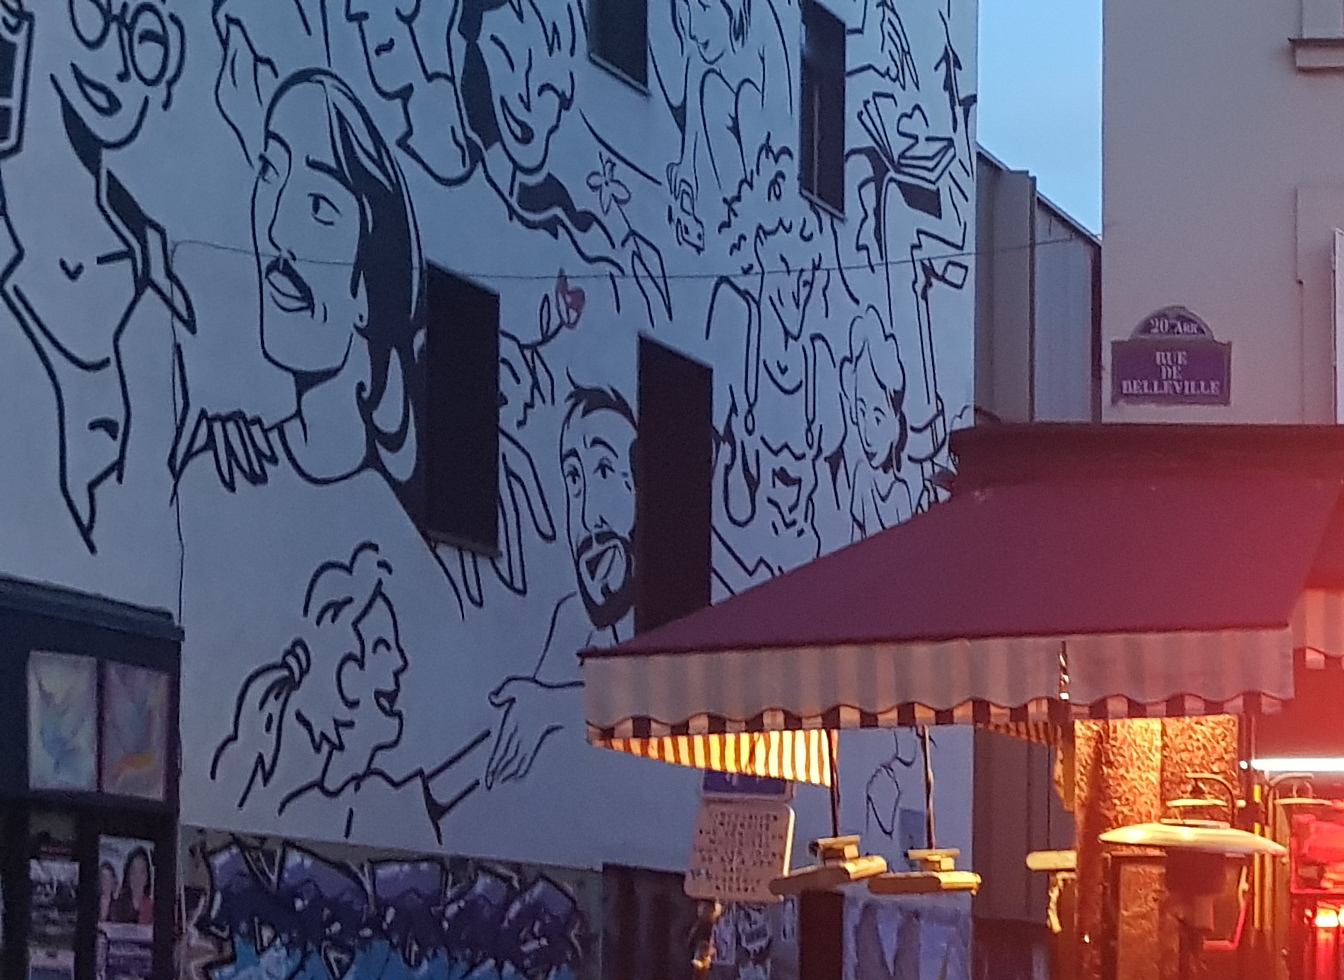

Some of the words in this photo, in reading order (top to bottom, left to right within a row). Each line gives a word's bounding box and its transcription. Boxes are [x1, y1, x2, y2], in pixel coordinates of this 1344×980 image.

[1155, 350, 1188, 366] RUE
[1161, 365, 1183, 379] DE
[1122, 380, 1221, 395] BELLEVILLE
